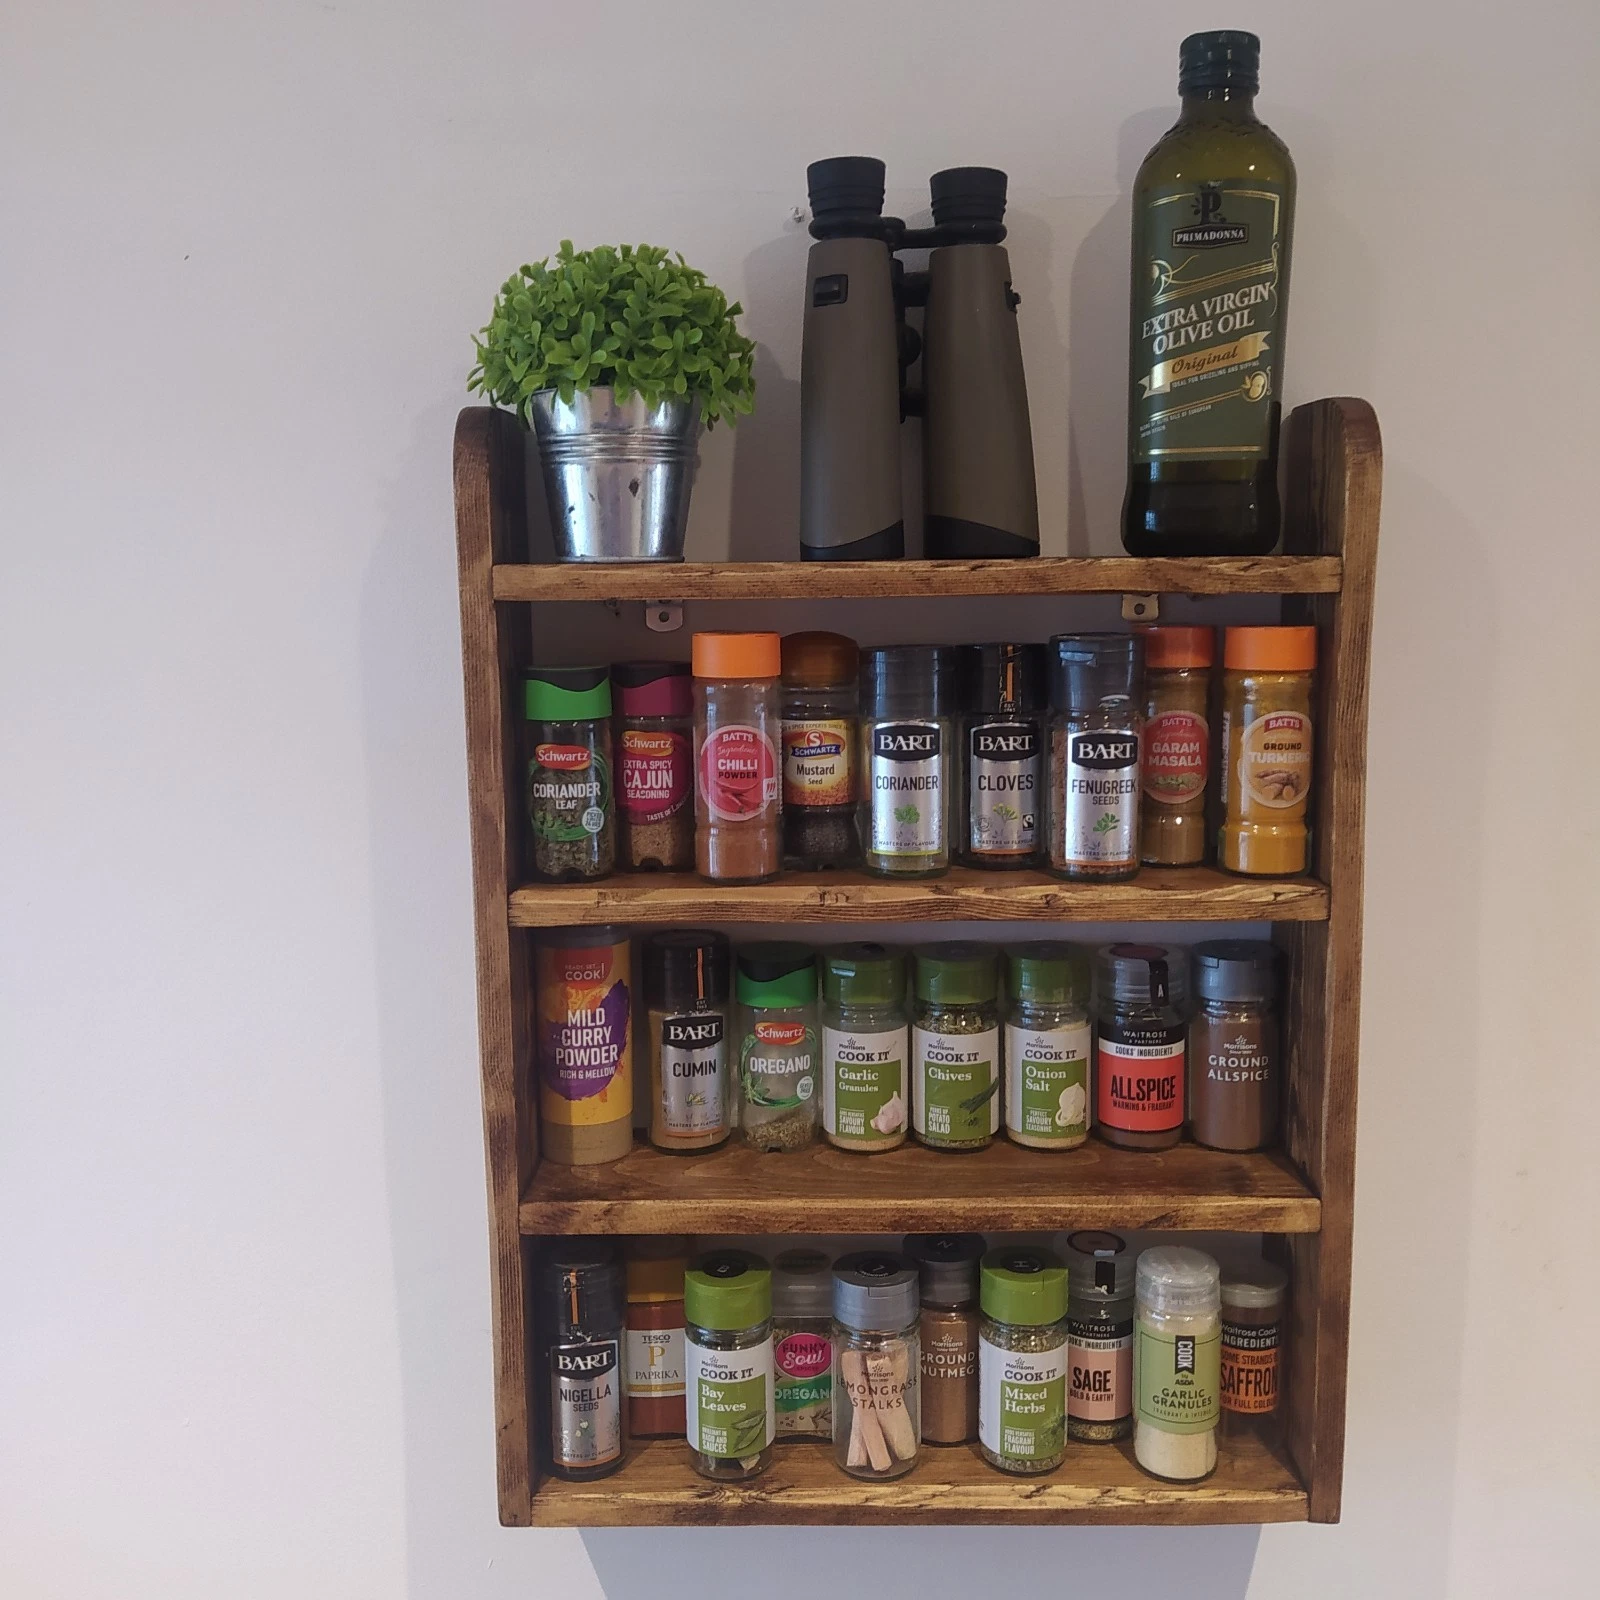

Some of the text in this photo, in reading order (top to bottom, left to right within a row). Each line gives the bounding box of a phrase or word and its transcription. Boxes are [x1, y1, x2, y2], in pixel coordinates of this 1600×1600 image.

[1176, 228, 1245, 243] PRIMADONNA
[1142, 281, 1271, 340] EXTRA VIRGIN
[1153, 308, 1254, 355] OLIVE OIL
[1172, 345, 1238, 374] Original
[1162, 717, 1193, 727] BATTS
[1268, 718, 1300, 729] BATTS
[623, 735, 671, 749] Schwartz
[722, 732, 753, 743] BATTS
[809, 732, 821, 747] S
[879, 733, 935, 751] BART
[979, 734, 1034, 751] BART
[794, 745, 837, 756] SCHWARTZ
[1077, 742, 1134, 760] BART
[1152, 742, 1200, 754] GARAM
[1263, 742, 1302, 751] GROUND
[537, 749, 588, 762] Schwartz
[1148, 754, 1202, 767] MASALA
[623, 759, 672, 770] EXTRA SPICY
[717, 758, 758, 771] CHILLI
[796, 763, 835, 776] Mustard
[623, 769, 673, 789] CAJUN
[718, 771, 758, 779] POWDER
[807, 777, 823, 785] Seed
[875, 775, 939, 791] CORIANDER
[978, 774, 1034, 791] CLOVES
[1071, 778, 1137, 794] FENUGREEK
[533, 781, 601, 799] CORIANDER
[626, 789, 670, 799] SEASONING
[555, 800, 578, 810] LEAF
[1092, 795, 1120, 806] SEEDS
[646, 809, 672, 821] TASTE OF
[567, 1007, 606, 1028] MILD
[561, 1025, 613, 1047] CURRY
[669, 1021, 719, 1040] BART
[757, 1026, 804, 1039] Schwartz
[1122, 1029, 1167, 1038] WAITROSE
[838, 1043, 866, 1051] Morrisons
[928, 1043, 955, 1051] Morrisons
[1025, 1041, 1054, 1049] Morrisons
[1115, 1045, 1174, 1057] COOKS' INGREDIENTS
[555, 1043, 619, 1067] POWDER
[838, 1050, 890, 1062] COOK IT
[927, 1050, 980, 1062] COOK IT
[1025, 1049, 1077, 1060] COOK IT
[1208, 1054, 1269, 1068] GROUND
[672, 1058, 717, 1078] CUMIN
[749, 1054, 811, 1075] OREGANO
[559, 1065, 616, 1080] RICH & MELLOW
[838, 1067, 879, 1081] Garlic
[928, 1066, 972, 1081] Chives
[1025, 1065, 1067, 1079] Onion
[1207, 1068, 1269, 1082] ALLSPICE
[838, 1081, 879, 1092] Granules
[1025, 1078, 1050, 1092] Salt
[1110, 1074, 1177, 1102] ALLSPICE
[1112, 1099, 1174, 1112] WARMING & FRAGRANT
[839, 1115, 865, 1127] SAVOURY
[928, 1112, 951, 1124] POTATO
[1025, 1114, 1053, 1126] SAVOURY
[839, 1123, 865, 1135] FLAVOUR
[928, 1121, 951, 1134] SALAD
[1025, 1122, 1053, 1133] SEASONING
[1071, 1320, 1117, 1332] WAITROSE
[642, 1334, 671, 1342] TESCO
[931, 1340, 964, 1348] Morrisons
[1084, 1339, 1122, 1350] INGREDIENTS
[782, 1342, 827, 1353] FUNKY
[557, 1349, 611, 1371] BART
[649, 1345, 666, 1367] P
[782, 1350, 825, 1369] Soul
[1177, 1340, 1193, 1369] COOK
[1241, 1353, 1273, 1366] STRANDS
[701, 1359, 729, 1369] Morrisons
[1005, 1362, 1035, 1370] Morrisons
[634, 1369, 679, 1380] PAPRIKA
[700, 1367, 754, 1381] COOK IT
[920, 1365, 975, 1378] NUTMEG
[1004, 1368, 1057, 1382] COOK IT
[836, 1374, 918, 1396] LEMONGRASS
[1072, 1366, 1112, 1393] SAGE
[559, 1383, 612, 1403] NIGELLA
[701, 1383, 725, 1401] Bay
[774, 1387, 832, 1400] OREGAN
[1004, 1385, 1048, 1401] Mixed
[1069, 1388, 1115, 1402] BOLD & EARTHY
[1161, 1387, 1206, 1400] GARLIC
[572, 1402, 599, 1413] SEEDS
[701, 1396, 747, 1412] Leaves
[852, 1397, 902, 1410] STALKS
[1004, 1399, 1046, 1414] Herbs
[1152, 1394, 1212, 1410] GRANULES
[1234, 1397, 1251, 1409] FULL
[716, 1435, 728, 1444] AND
[1004, 1433, 1035, 1445] FRAGRANT
[702, 1439, 727, 1454] SAUCES
[1004, 1442, 1035, 1455] FLAVOUR
